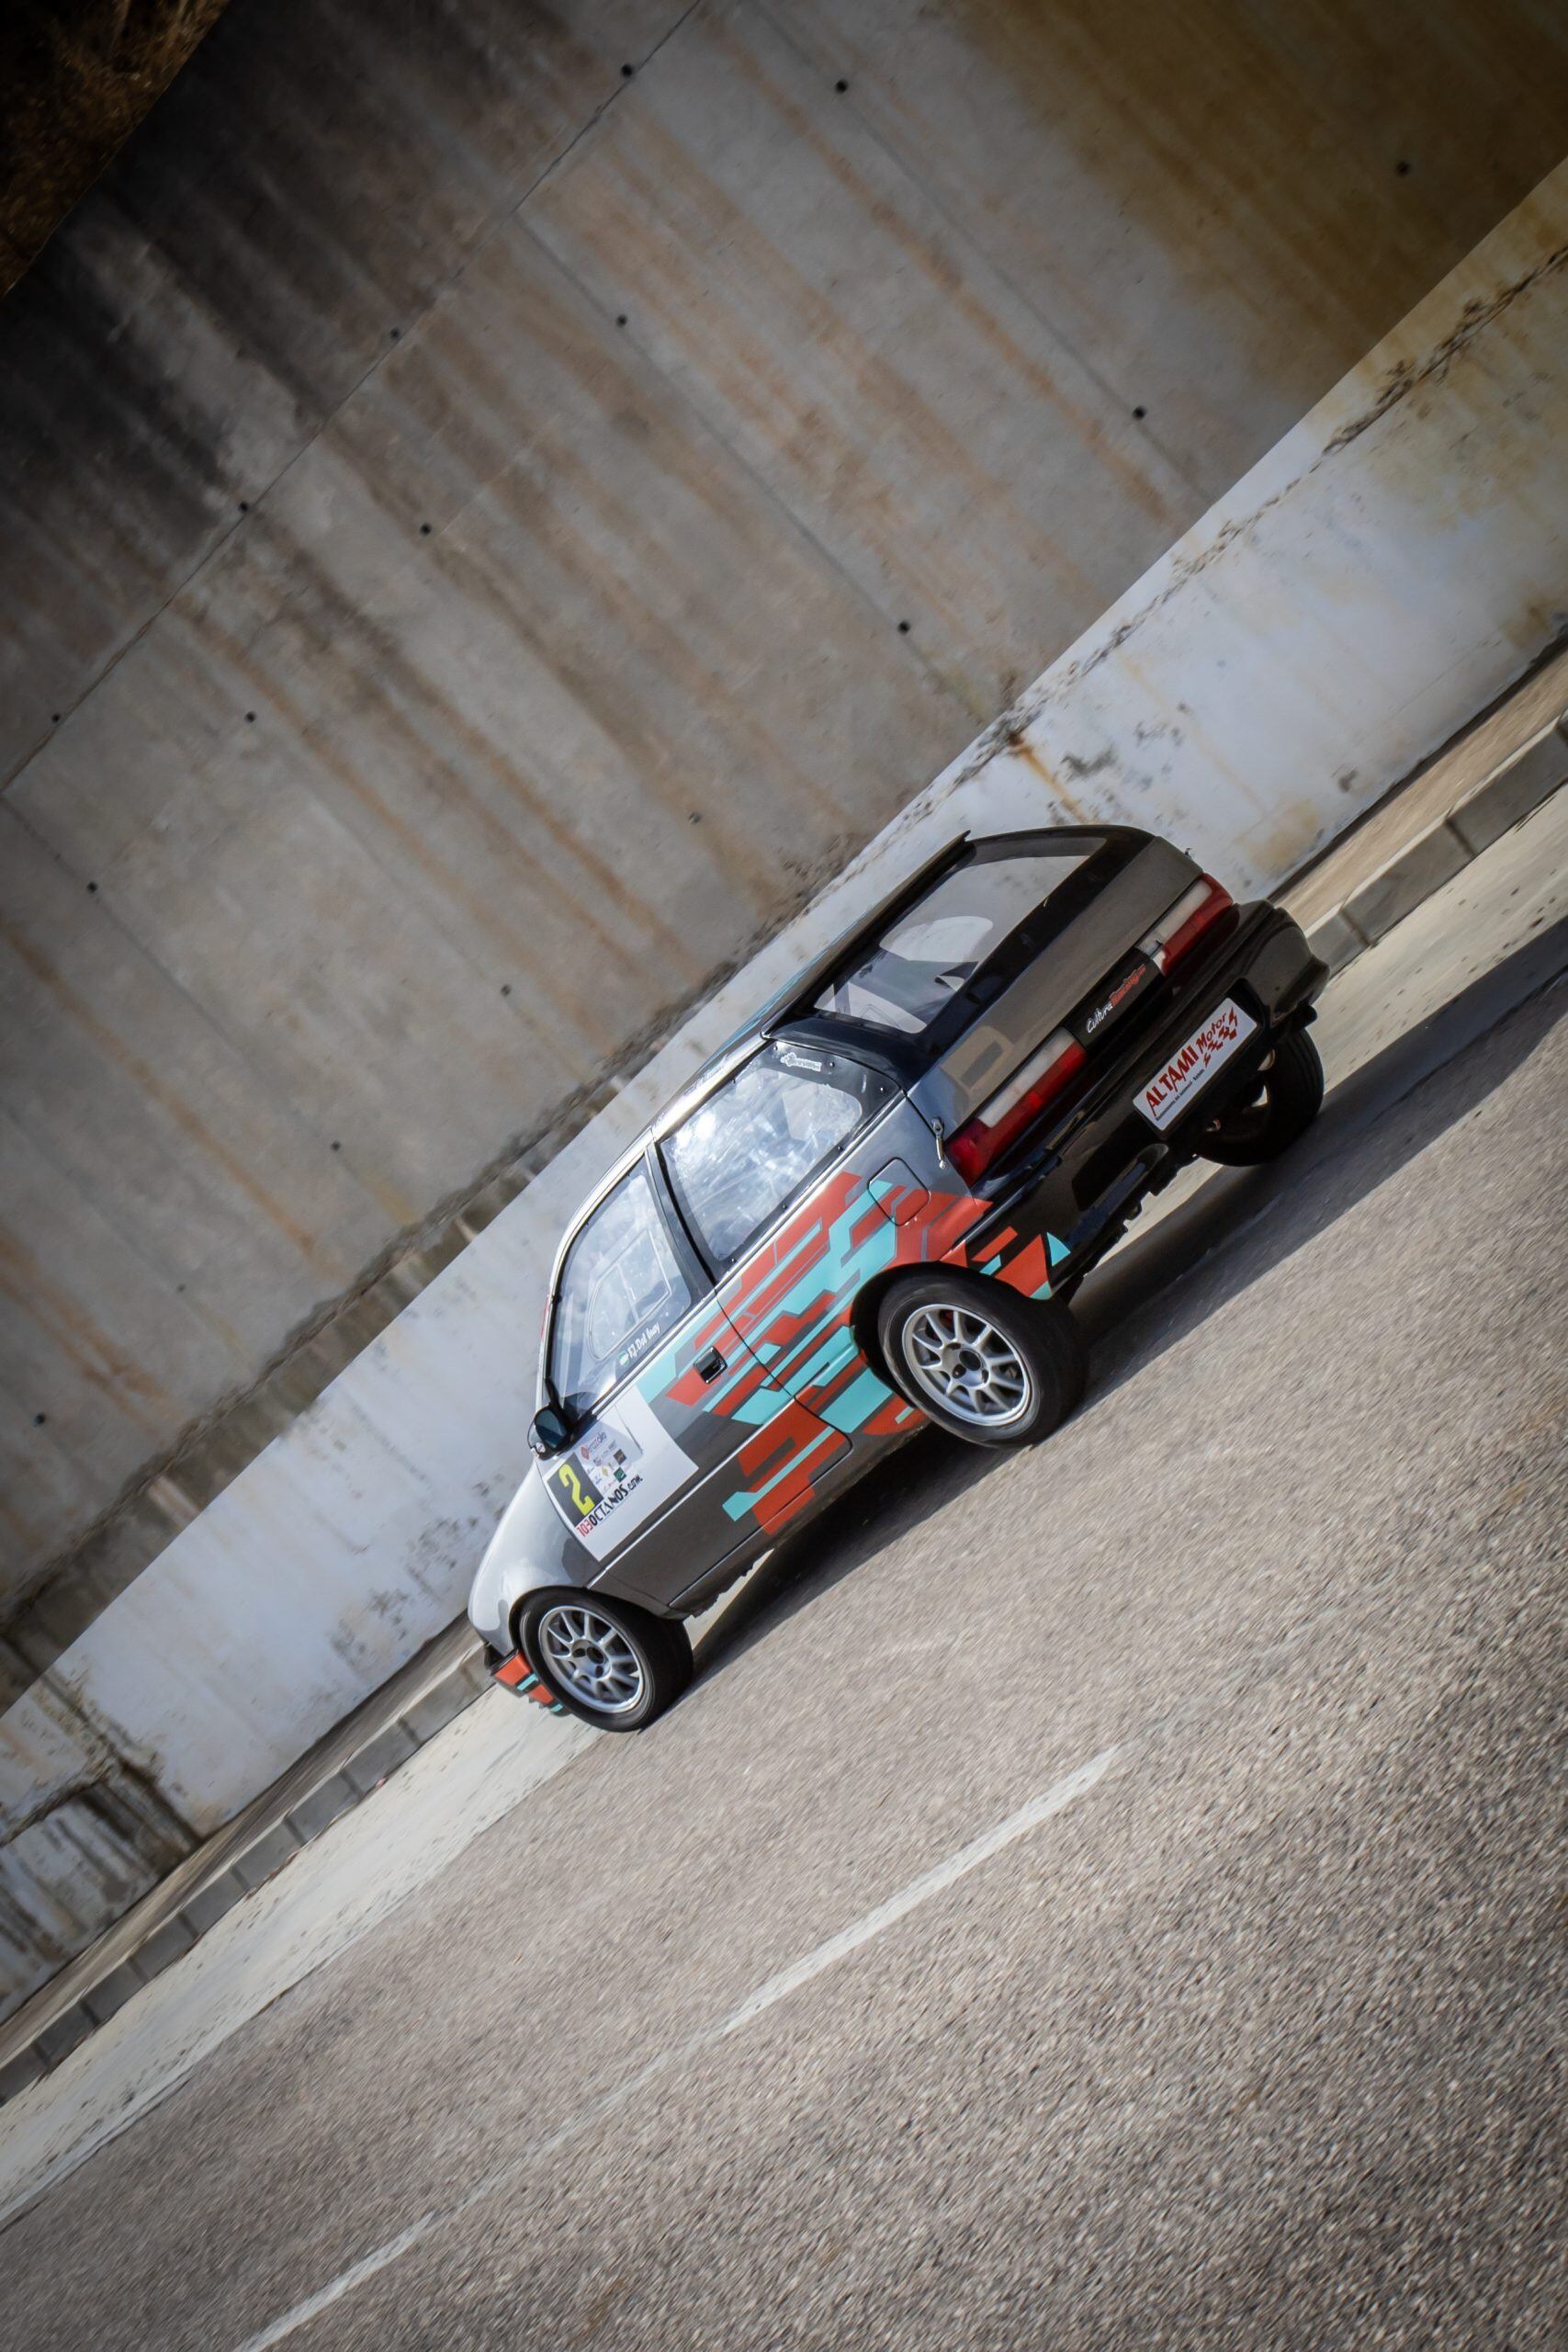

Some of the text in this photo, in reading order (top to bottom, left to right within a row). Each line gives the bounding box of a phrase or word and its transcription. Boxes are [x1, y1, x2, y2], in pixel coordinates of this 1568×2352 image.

[1145, 1046, 1199, 1117] ALTAMI
[1196, 1013, 1226, 1054] Motor
[558, 1464, 595, 1516] 2
